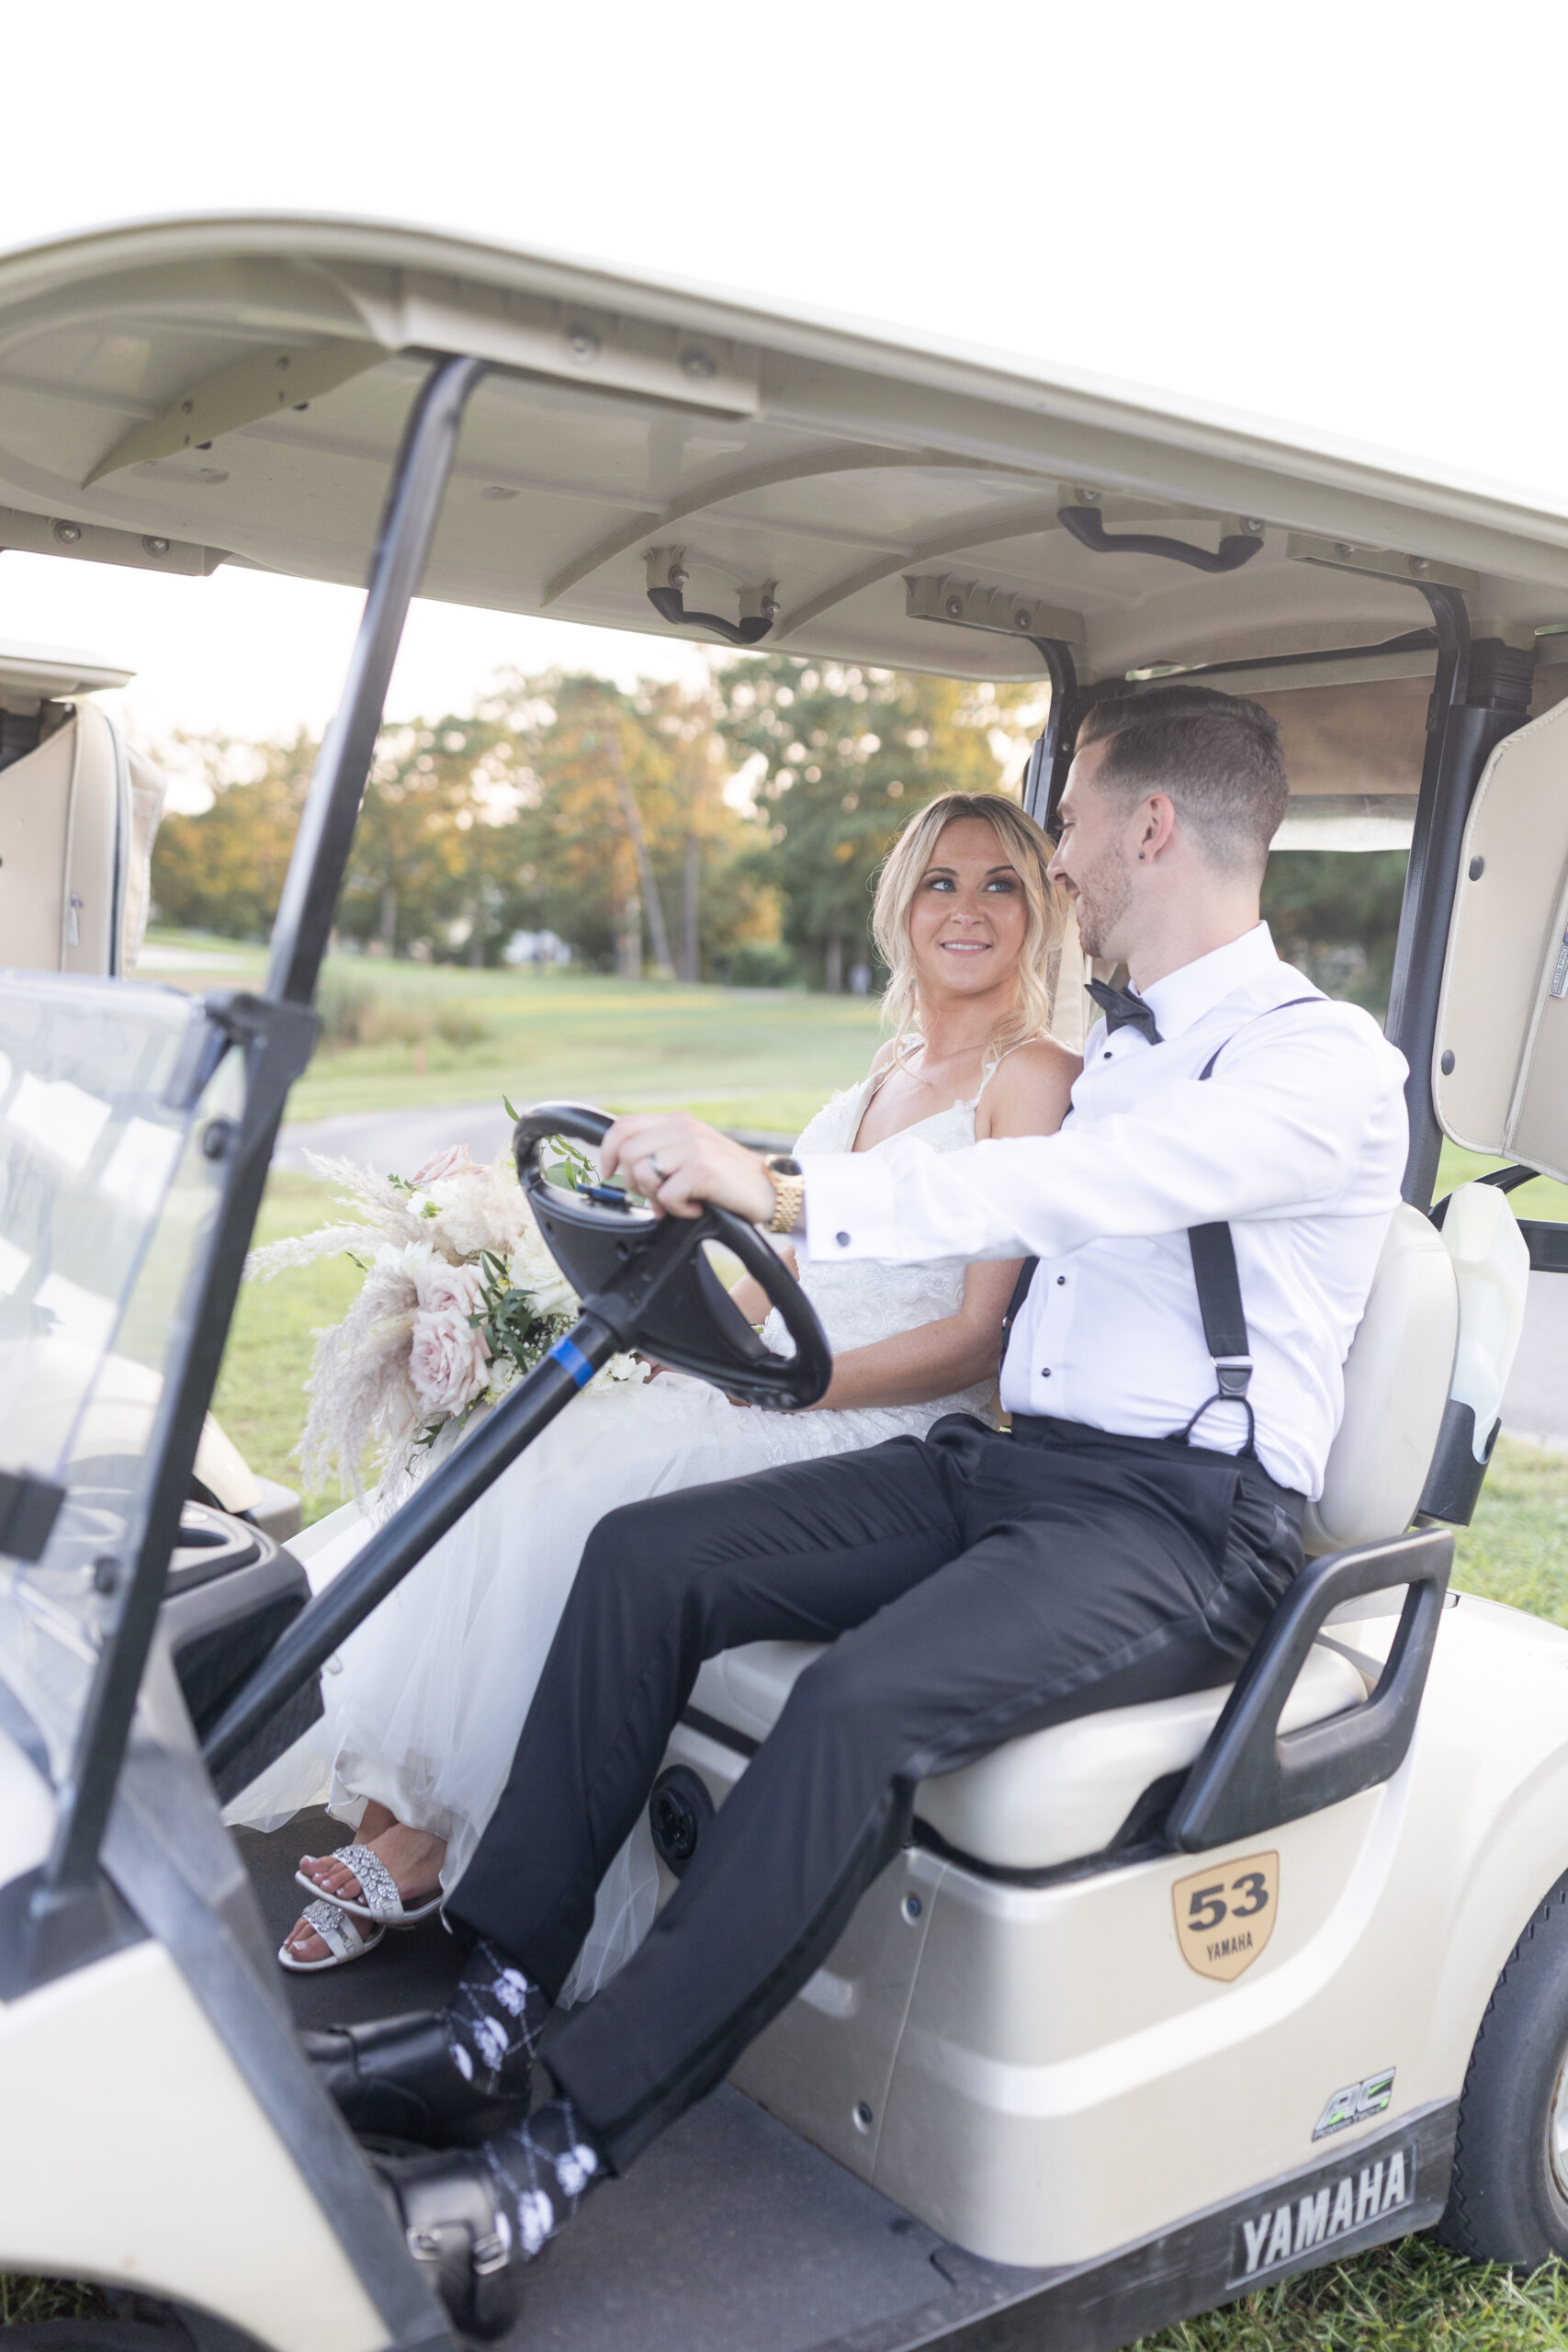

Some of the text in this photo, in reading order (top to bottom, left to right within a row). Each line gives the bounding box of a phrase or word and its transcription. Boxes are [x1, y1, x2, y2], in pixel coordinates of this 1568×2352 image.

[1188, 1873, 1269, 1931] 53
[1207, 1931, 1253, 1962] YAMAHA
[1243, 2151, 1405, 2274] YAMAHA
